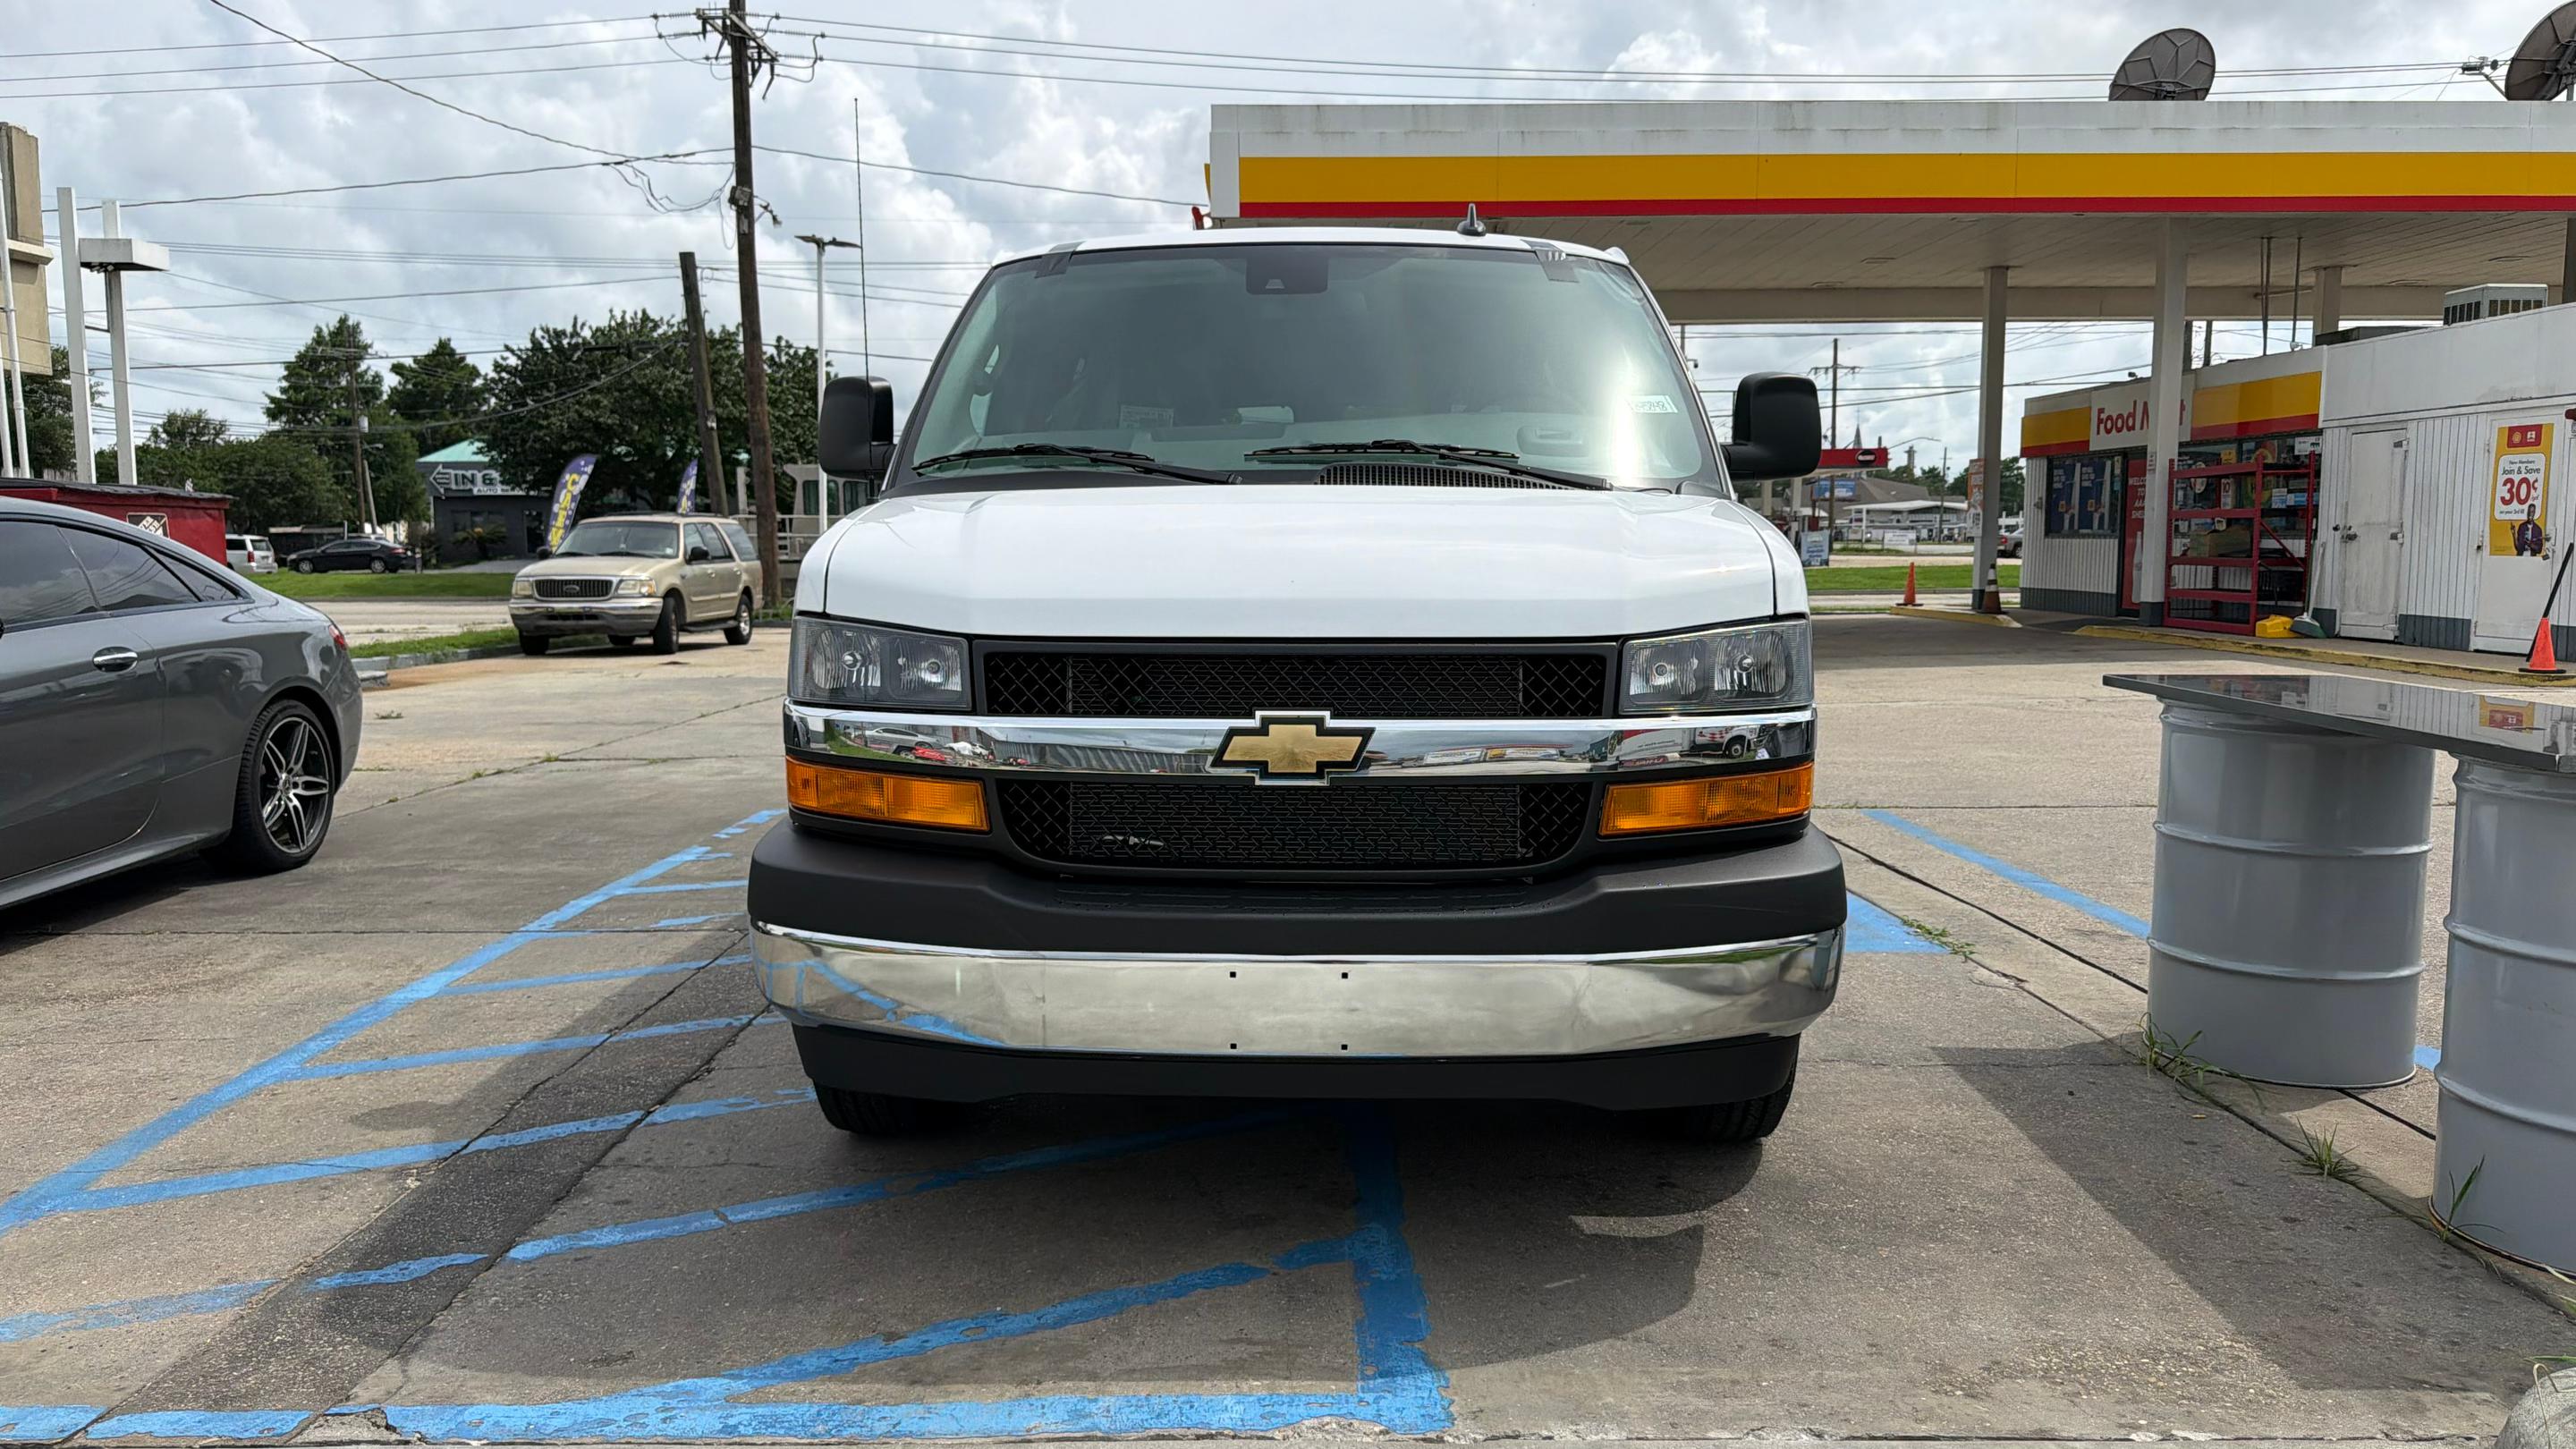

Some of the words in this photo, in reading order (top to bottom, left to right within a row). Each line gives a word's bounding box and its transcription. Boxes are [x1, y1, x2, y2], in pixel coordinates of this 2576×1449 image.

[2096, 399, 2138, 436] Food
[2502, 466, 2515, 475] Join
[2516, 466, 2522, 475] &
[2524, 465, 2541, 475] Save
